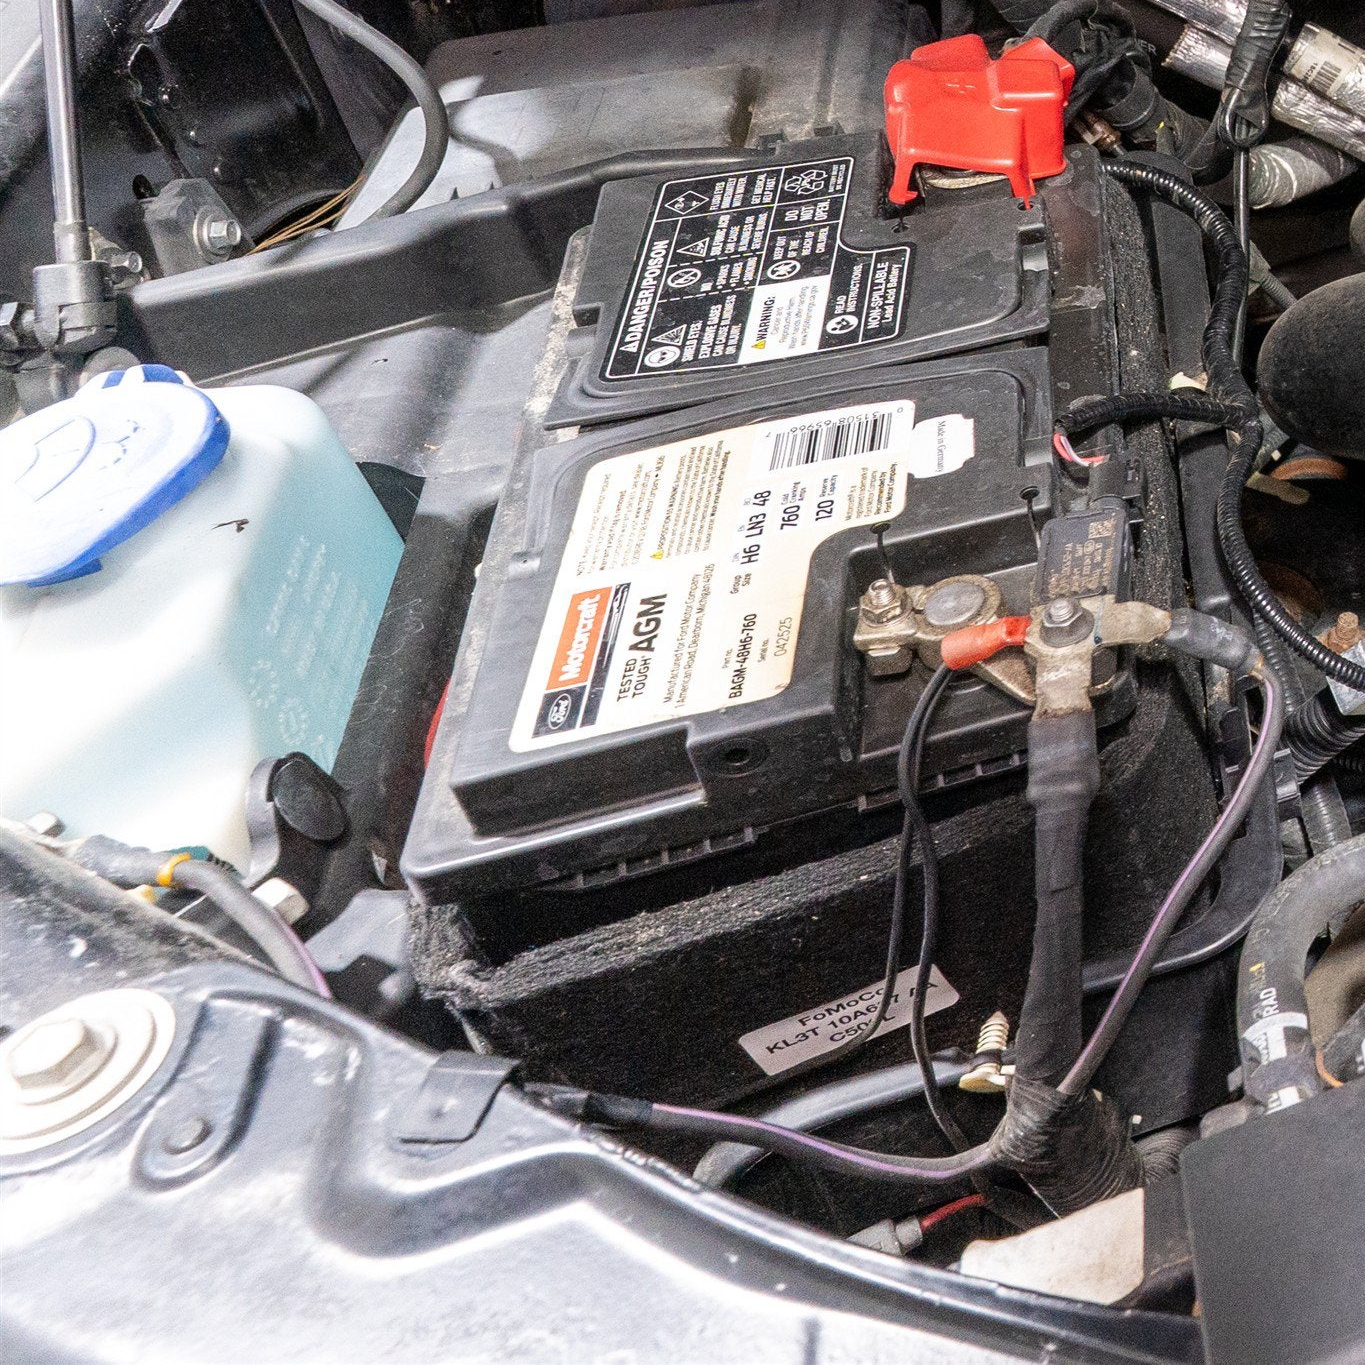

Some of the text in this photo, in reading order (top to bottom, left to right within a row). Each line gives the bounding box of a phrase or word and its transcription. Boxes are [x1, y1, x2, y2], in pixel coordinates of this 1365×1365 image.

[713, 181, 725, 194] EYES
[762, 190, 772, 203] HELP
[750, 194, 761, 204] GET
[814, 199, 830, 220] OPEN.
[717, 214, 730, 227] ACID
[784, 209, 799, 221] DO
[799, 205, 814, 221] NOT
[724, 225, 740, 253] CAN CAUSE
[738, 215, 754, 251] BLINDNESS OR
[750, 230, 763, 249] SEVERE
[801, 230, 814, 255] REACH OF
[773, 235, 786, 260] KEEP OUT
[786, 239, 799, 258] OF THE
[729, 261, 743, 283] FLAMES
[743, 256, 757, 280] SMOKING
[625, 240, 667, 341] DANGER/POISON
[846, 263, 862, 312] INSTRUCTIONS.
[867, 262, 888, 328] NON-SPILLABLE
[881, 263, 902, 322] Lead Acid Battery
[834, 295, 846, 314] READ
[712, 294, 736, 356] CAN CAUSE BLINDNESS
[756, 296, 774, 341] WARNING:
[698, 304, 721, 358] EXPLOSIVE GASES
[681, 339, 697, 361] SHIELD
[724, 345, 736, 354] OR
[935, 445, 946, 473] Germany
[789, 481, 800, 503] Cranking
[797, 487, 806, 501] Amps
[819, 477, 828, 497] Reserve
[827, 474, 837, 495] Capacity
[885, 486, 893, 501] Motor
[780, 493, 789, 505] Cold
[866, 492, 874, 506] Motor
[874, 478, 885, 514] Recommended
[883, 501, 892, 513] Ford
[780, 504, 800, 529] 760
[815, 499, 834, 521] 120
[863, 505, 872, 517] Ford
[740, 490, 771, 564] H6 LN3 48
[702, 563, 715, 583] 48126
[729, 574, 742, 594] Group
[741, 573, 751, 586] Size
[695, 583, 710, 614] Michigan
[629, 594, 666, 651] AGM
[687, 613, 704, 648] Dearborn,
[663, 573, 700, 703] Manufactured for Ford Motor Company
[773, 616, 792, 656] 042525
[683, 648, 697, 669] Road,
[721, 656, 730, 668] Part
[729, 613, 756, 698] BAGM-48H6-760
[757, 647, 767, 662] Serial
[616, 658, 636, 701] TESTED
[676, 669, 691, 703] American
[765, 1026, 820, 1054] KL3T
[827, 993, 900, 1030] 10A67
[829, 1015, 896, 1043] C50L
